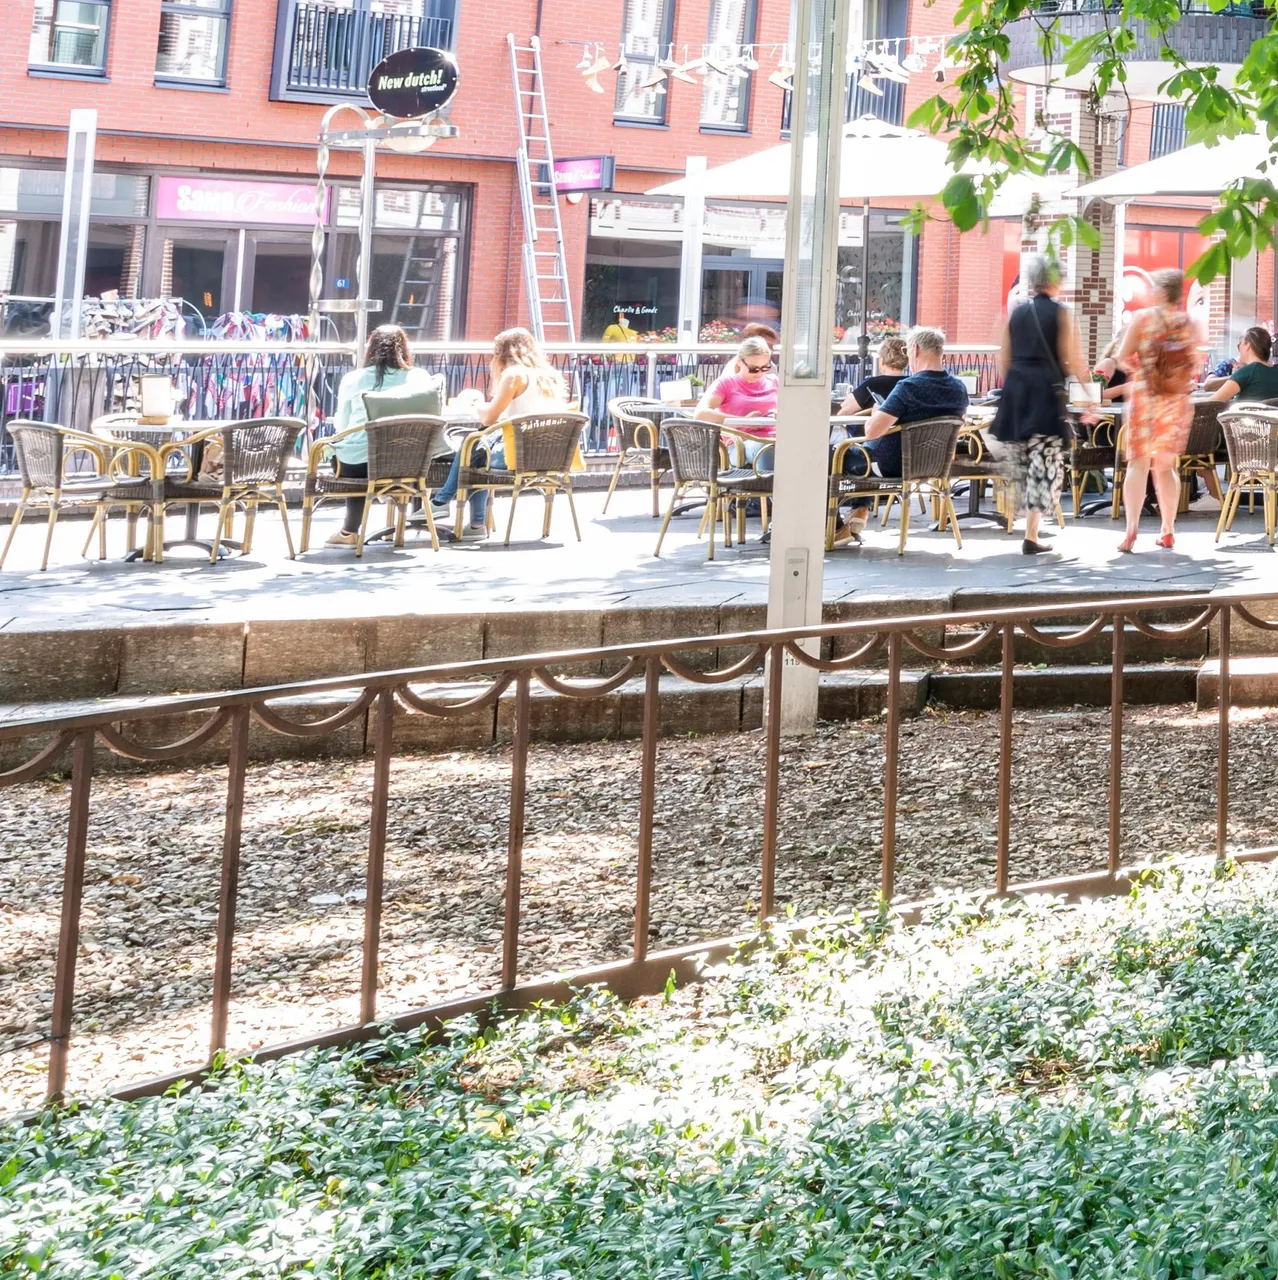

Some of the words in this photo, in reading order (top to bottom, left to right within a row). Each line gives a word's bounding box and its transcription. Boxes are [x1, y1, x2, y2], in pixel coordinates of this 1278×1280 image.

[378, 75, 404, 90] New
[404, 69, 443, 88] dutch!
[337, 279, 345, 288] 61
